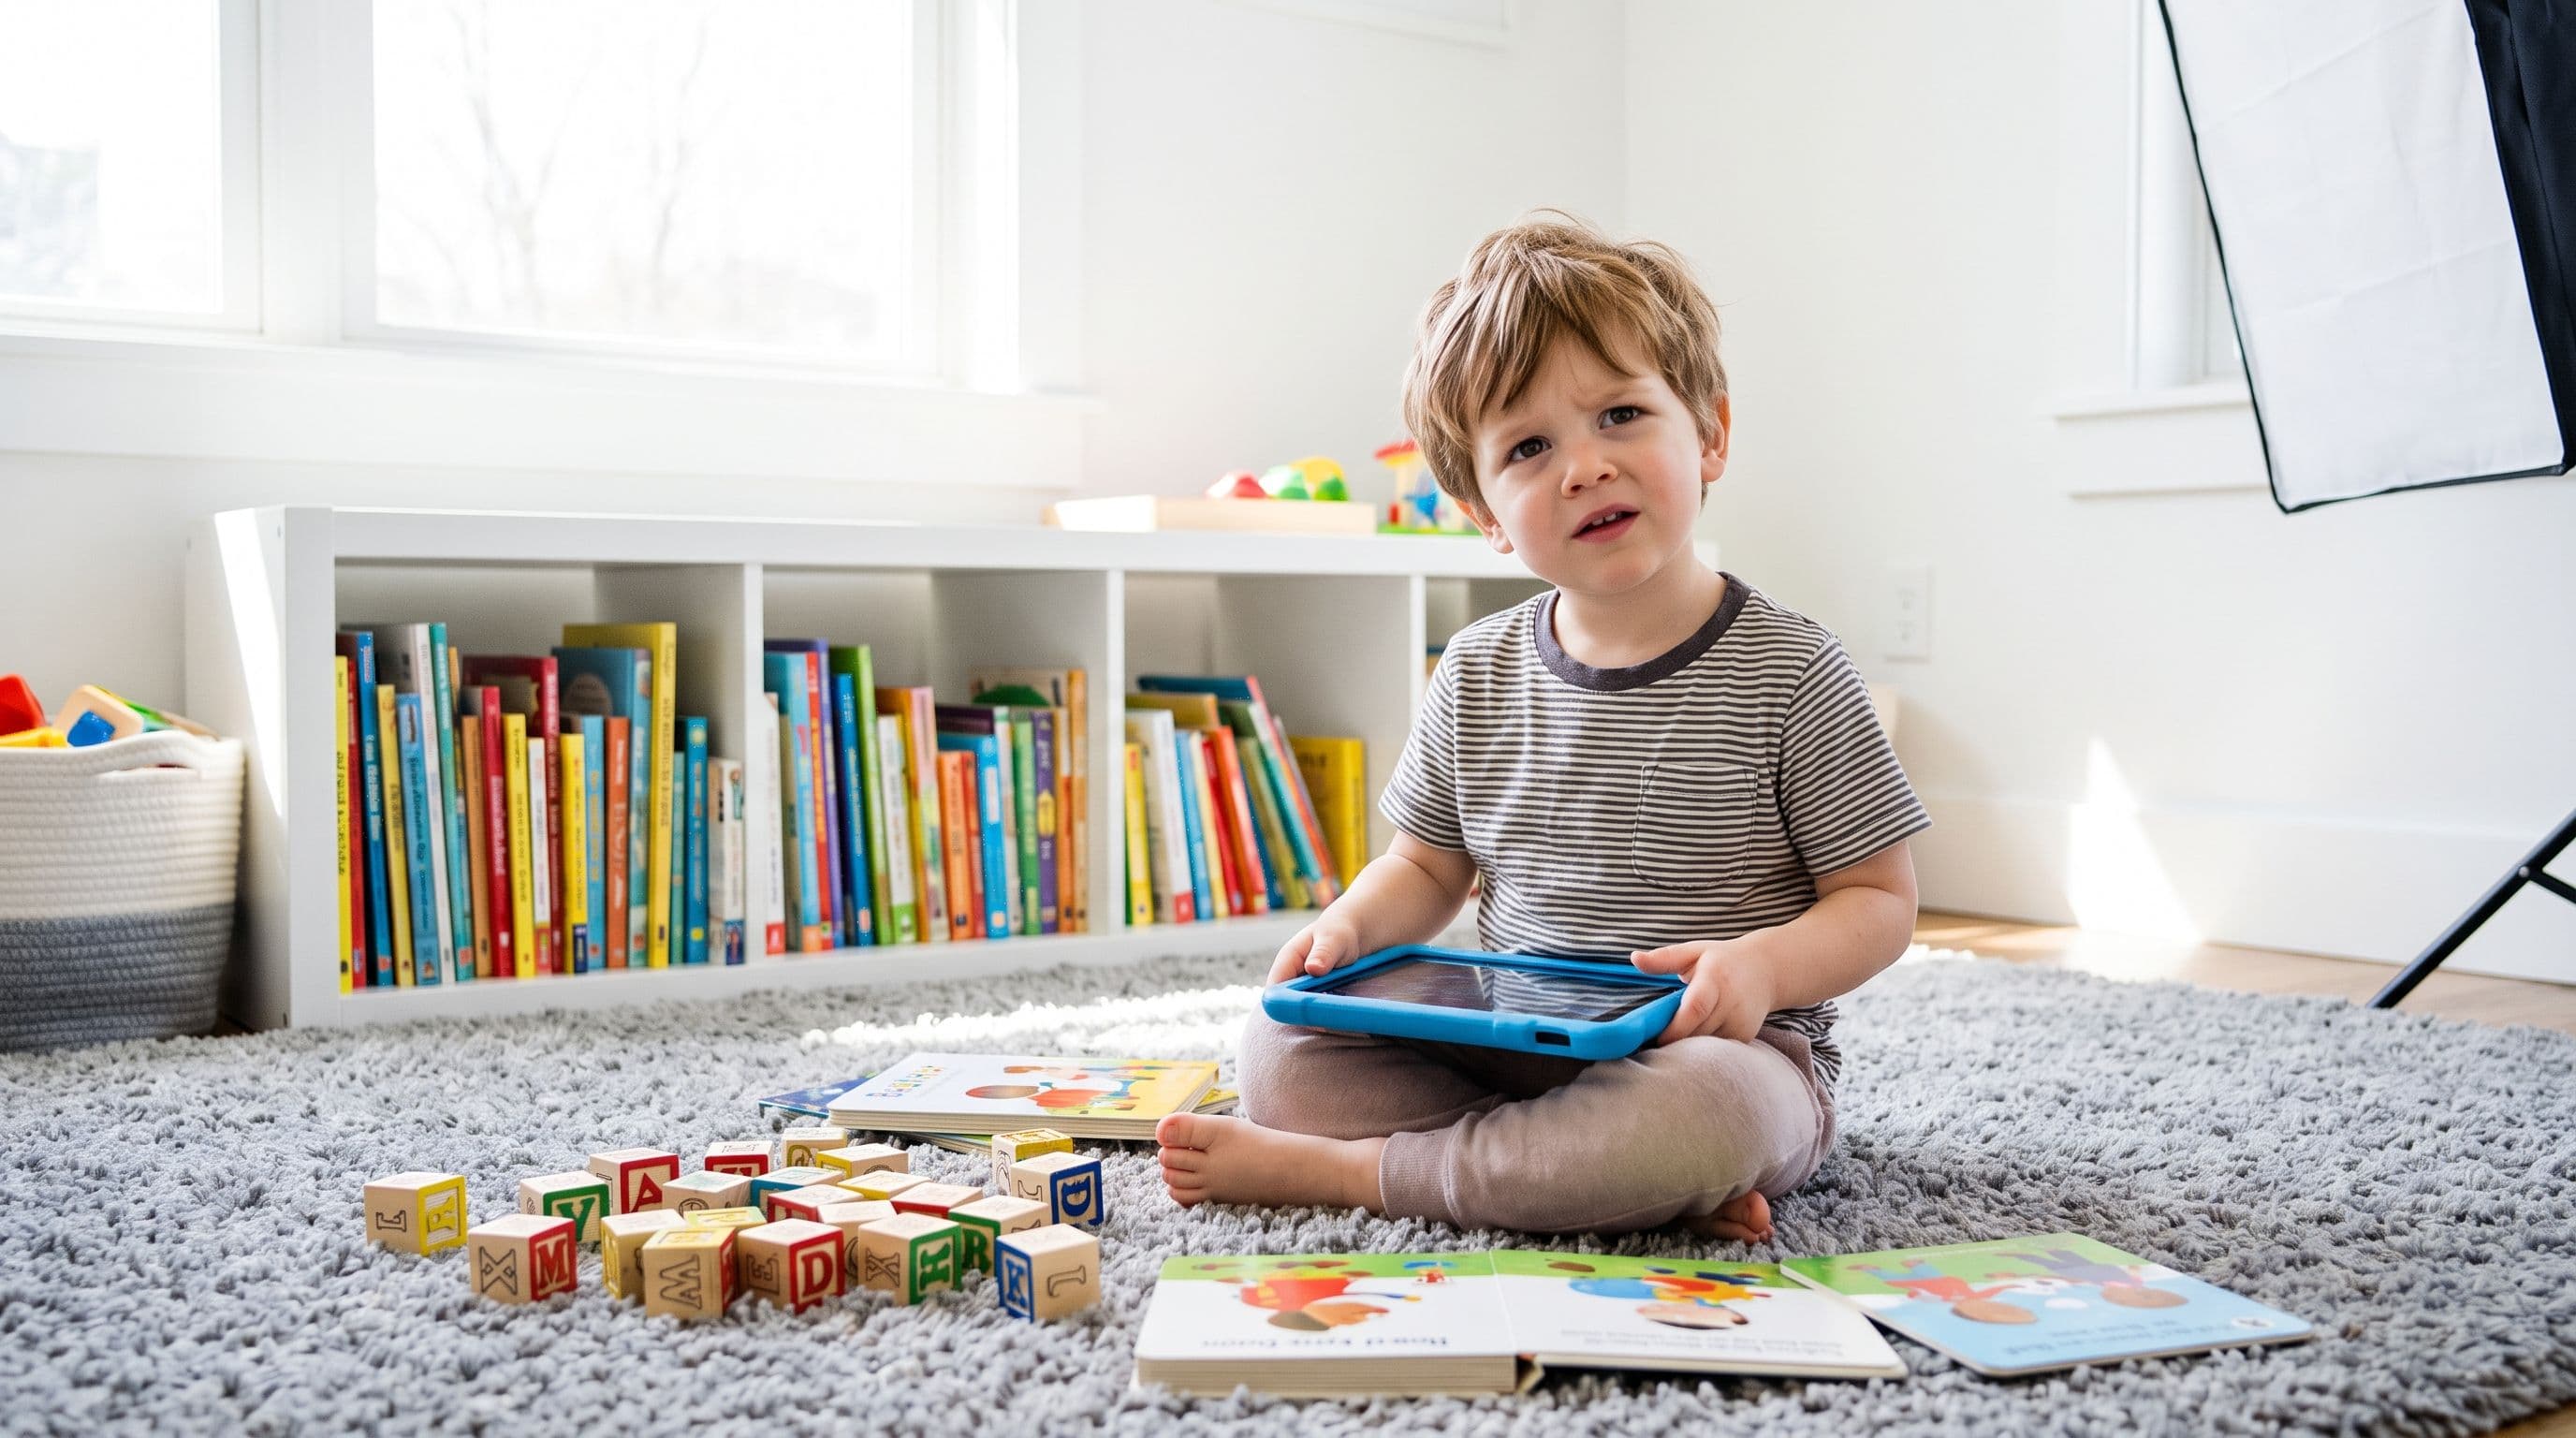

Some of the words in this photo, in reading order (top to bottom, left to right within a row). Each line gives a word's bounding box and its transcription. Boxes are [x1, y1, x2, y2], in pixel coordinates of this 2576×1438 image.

[1061, 1176, 1091, 1217] D
[537, 1240, 568, 1290] M
[801, 1250, 834, 1298] D
[1005, 1257, 1029, 1309] K
